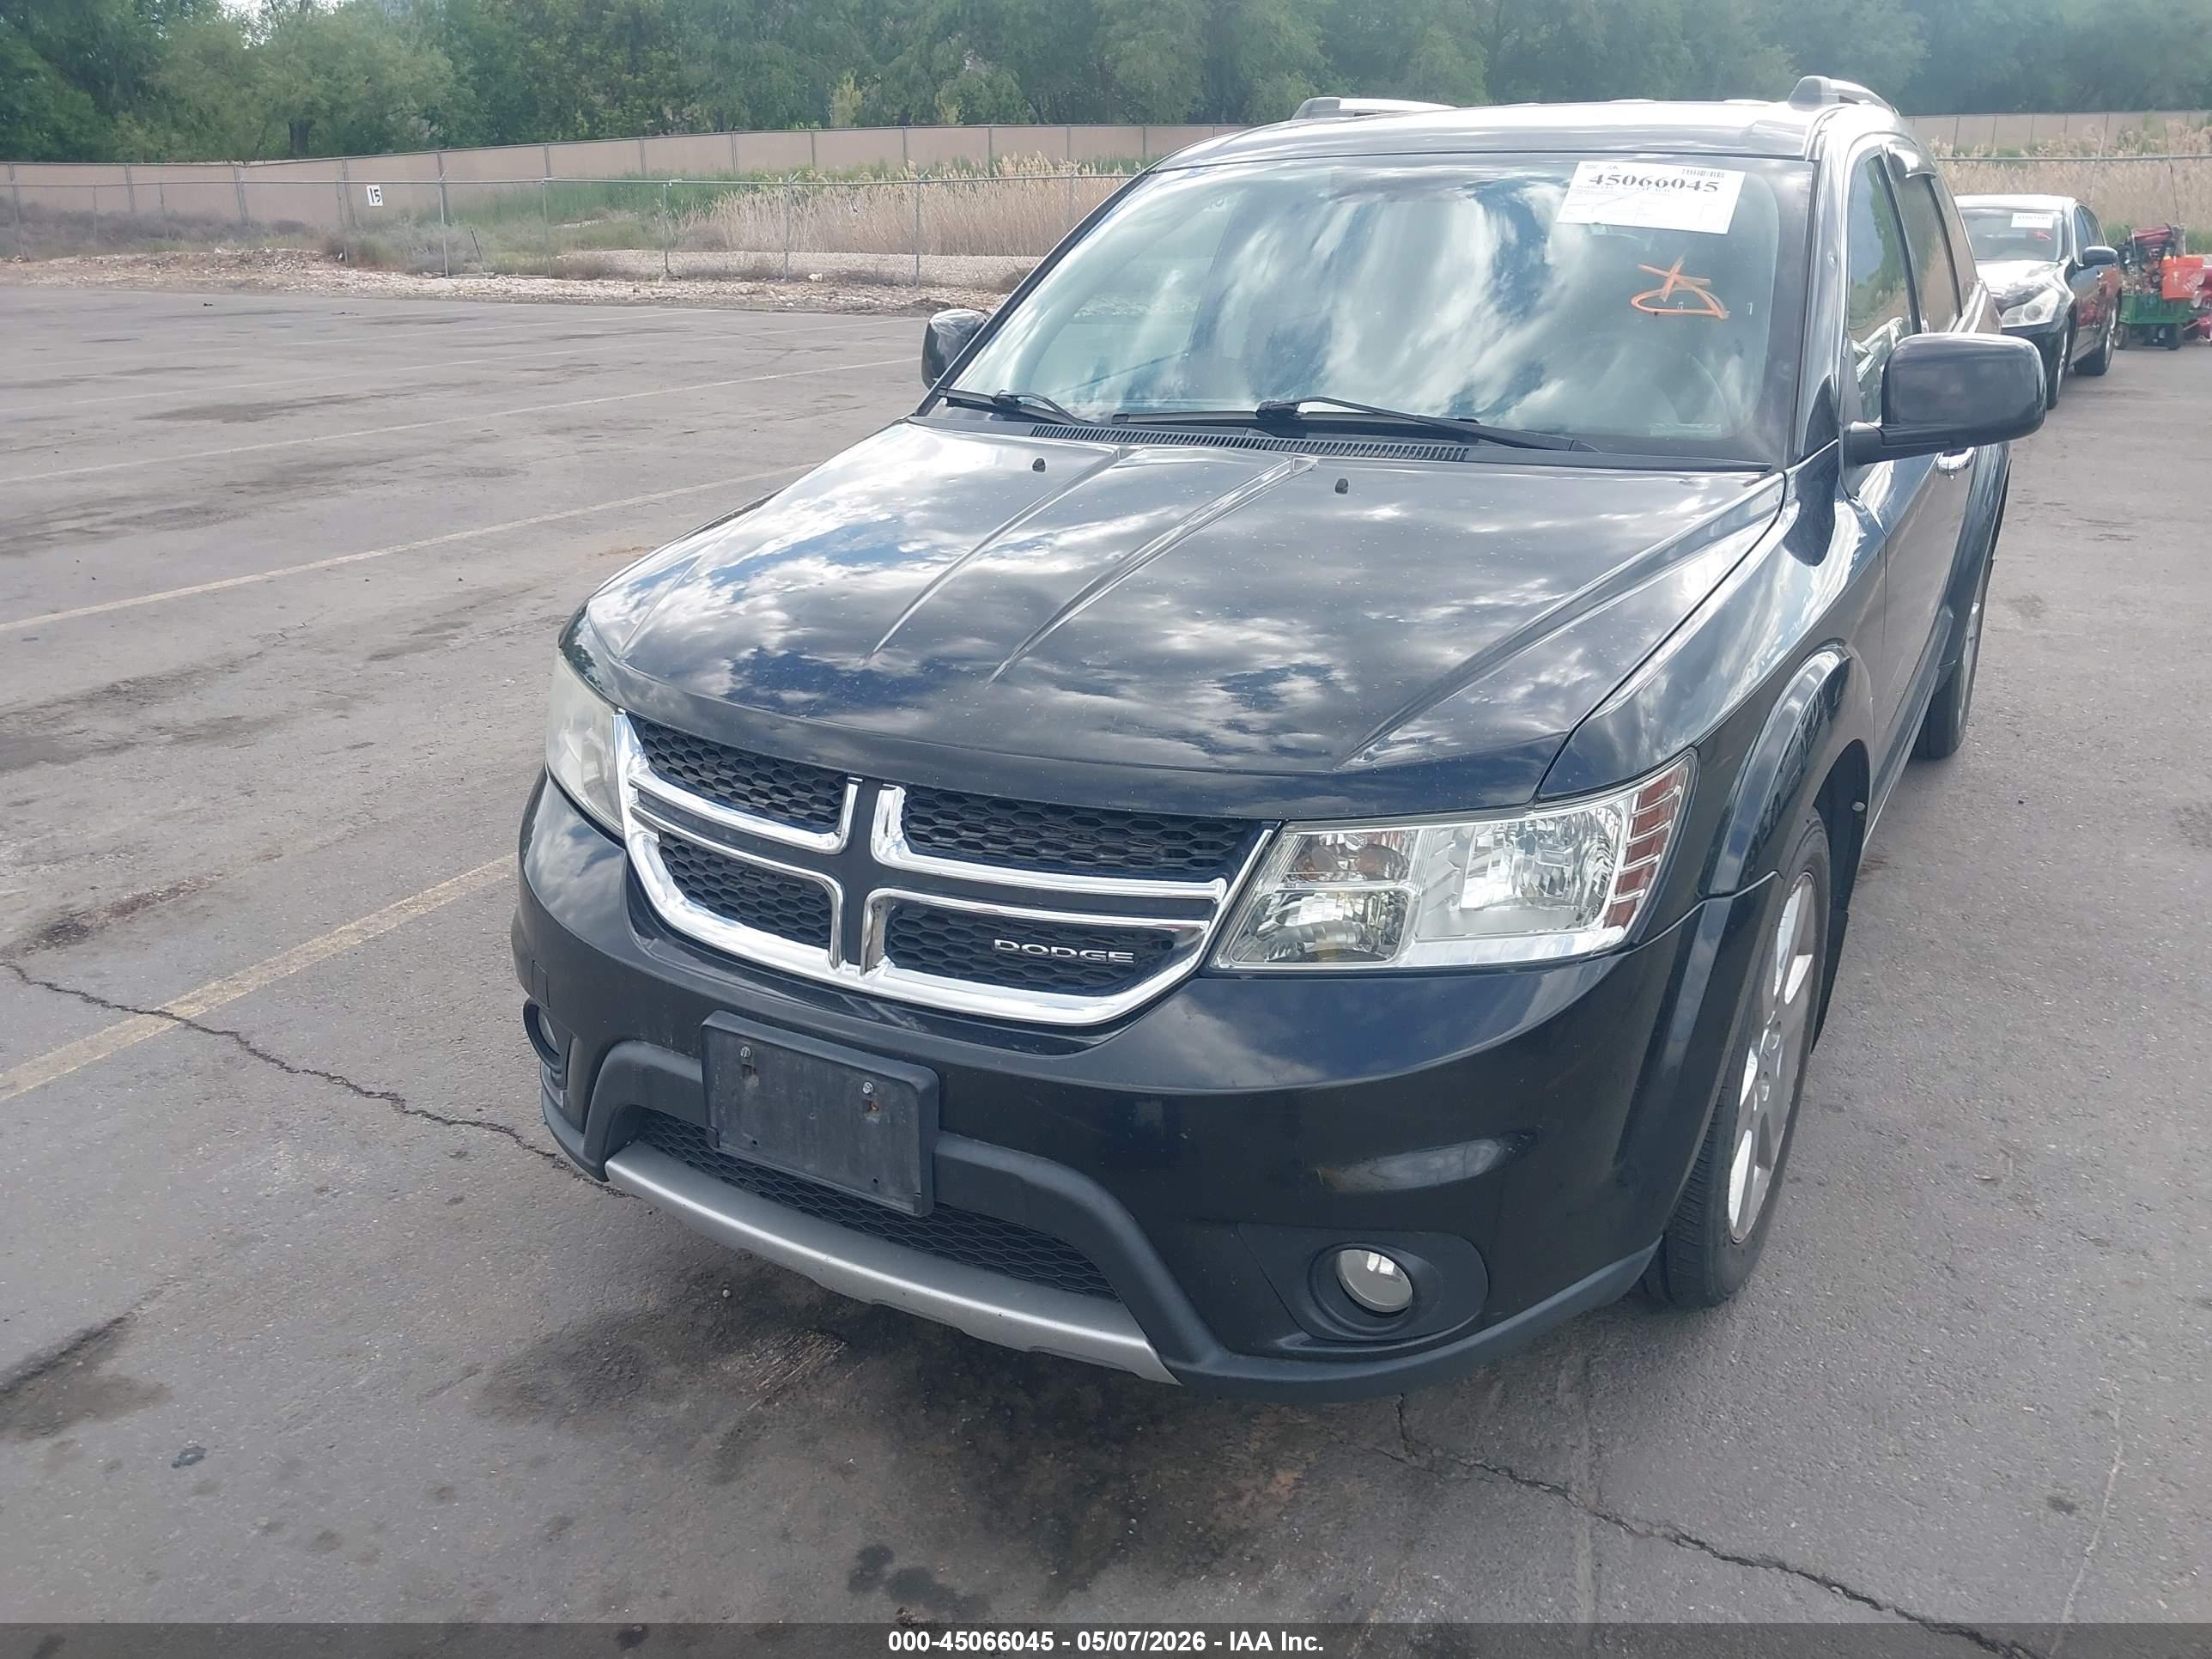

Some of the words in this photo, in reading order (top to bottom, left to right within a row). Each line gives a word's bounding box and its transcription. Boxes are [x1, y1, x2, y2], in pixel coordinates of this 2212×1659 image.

[1588, 173, 1720, 193] 45066045
[369, 187, 381, 204] 15
[994, 939, 1134, 963] DODGE
